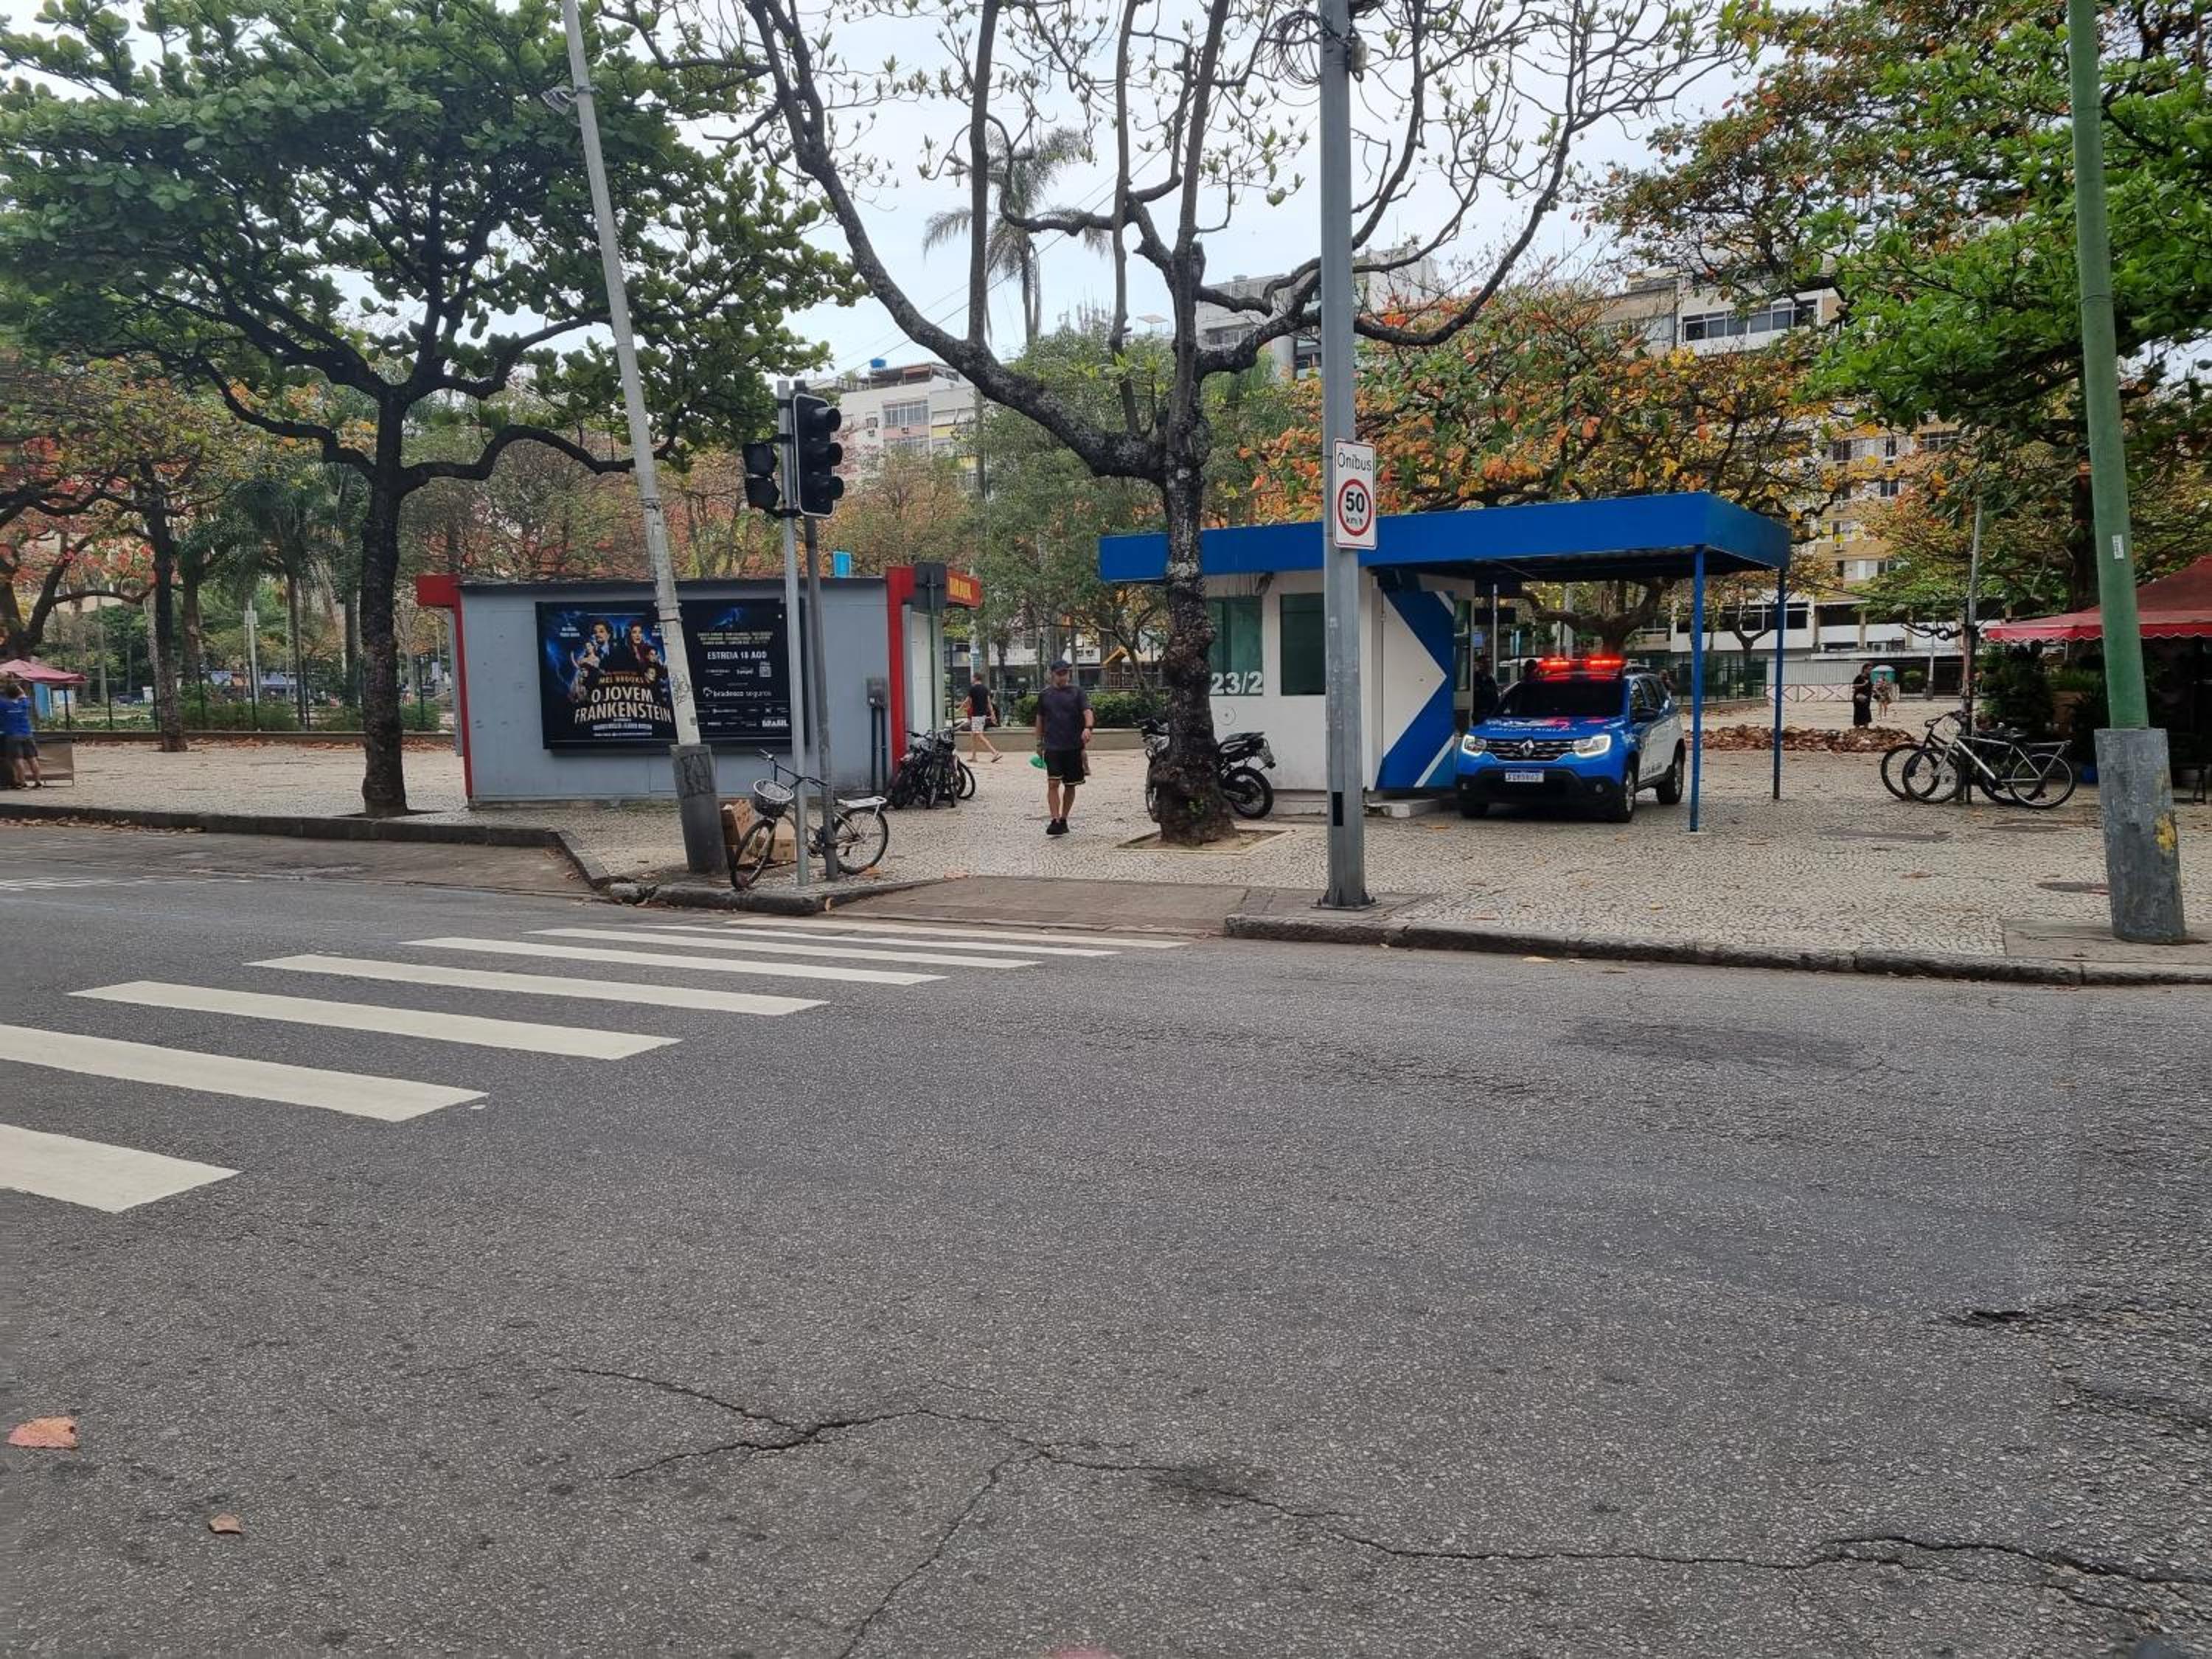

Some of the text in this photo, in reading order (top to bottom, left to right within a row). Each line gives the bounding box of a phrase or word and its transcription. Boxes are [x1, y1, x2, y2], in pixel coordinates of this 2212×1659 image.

[1337, 448, 1372, 471] Ônibus
[1346, 491, 1365, 513] 50
[707, 651, 739, 660] ESTREIA
[1209, 671, 1263, 695] 23/2
[591, 686, 654, 703] O JOVEM
[574, 702, 672, 724] FRANKENSTEIN
